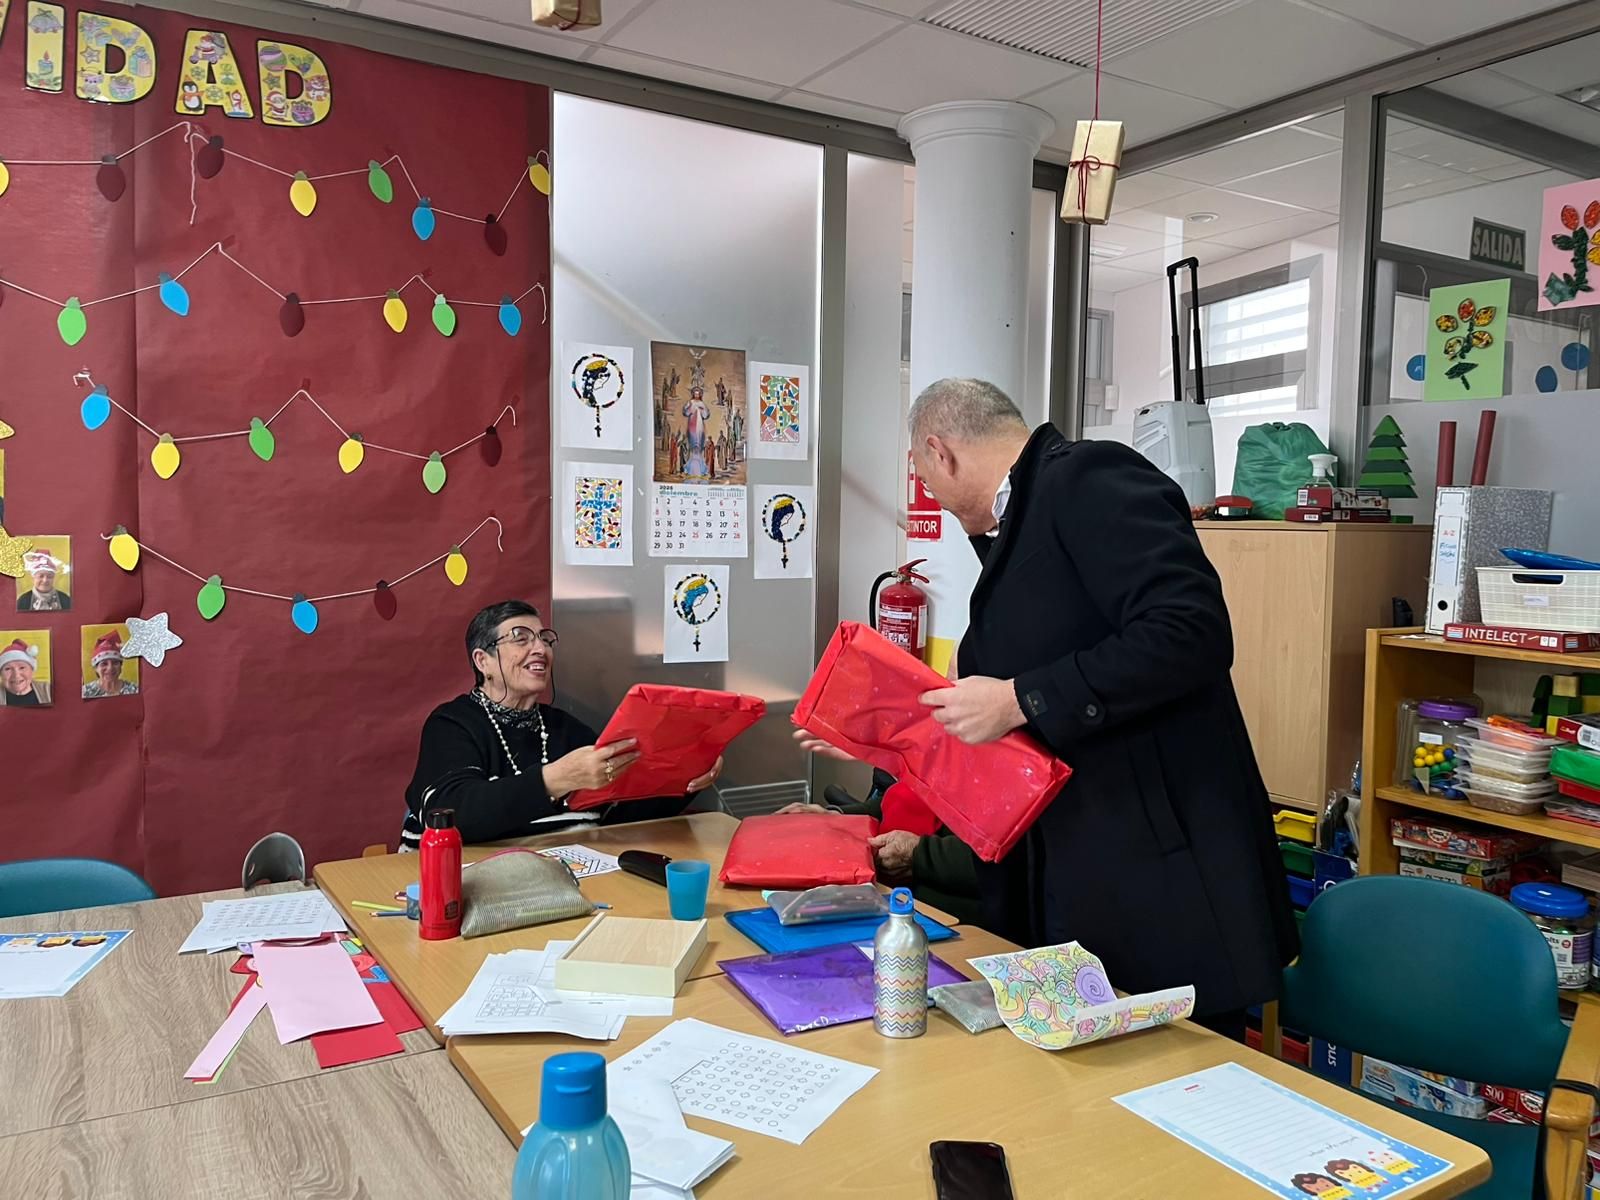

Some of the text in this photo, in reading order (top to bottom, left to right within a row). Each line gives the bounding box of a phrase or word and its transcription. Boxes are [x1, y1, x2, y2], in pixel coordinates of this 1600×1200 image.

[0, 0, 333, 127] IDAD
[1472, 226, 1522, 265] SALIDA
[1464, 628, 1528, 643] INTELECT
[1485, 1084, 1504, 1102] 500
